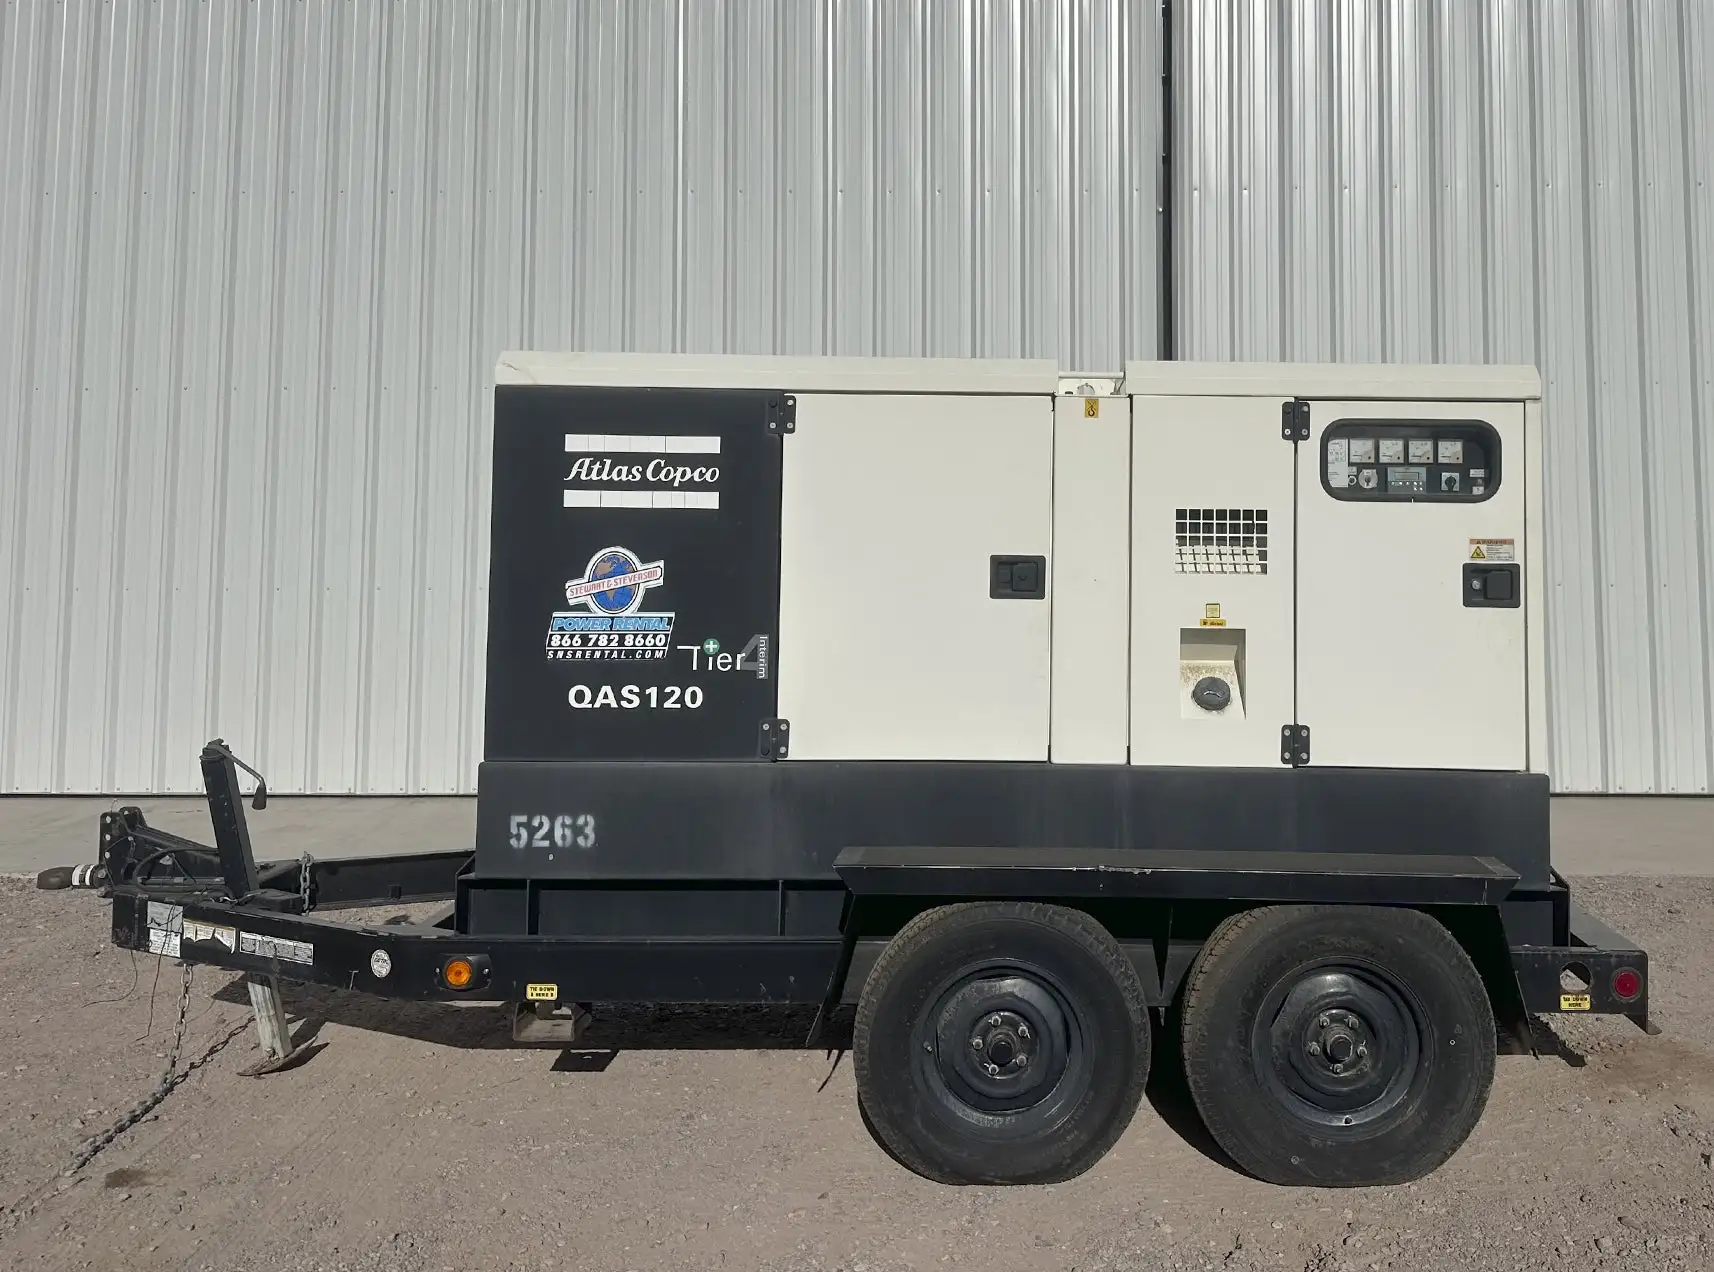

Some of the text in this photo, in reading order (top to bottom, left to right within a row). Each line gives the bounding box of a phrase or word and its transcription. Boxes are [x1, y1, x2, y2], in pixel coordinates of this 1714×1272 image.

[564, 457, 719, 486] Atlas Copco
[569, 581, 605, 597] STEWART
[613, 569, 658, 586] STEVENSON
[552, 617, 671, 631] POWER RENTAL
[550, 634, 666, 647] 866 782 8660
[547, 650, 664, 659] SNSRENTAL.COM
[759, 636, 768, 679] Interim
[568, 684, 703, 709] QAS120
[509, 814, 596, 848] 5263
